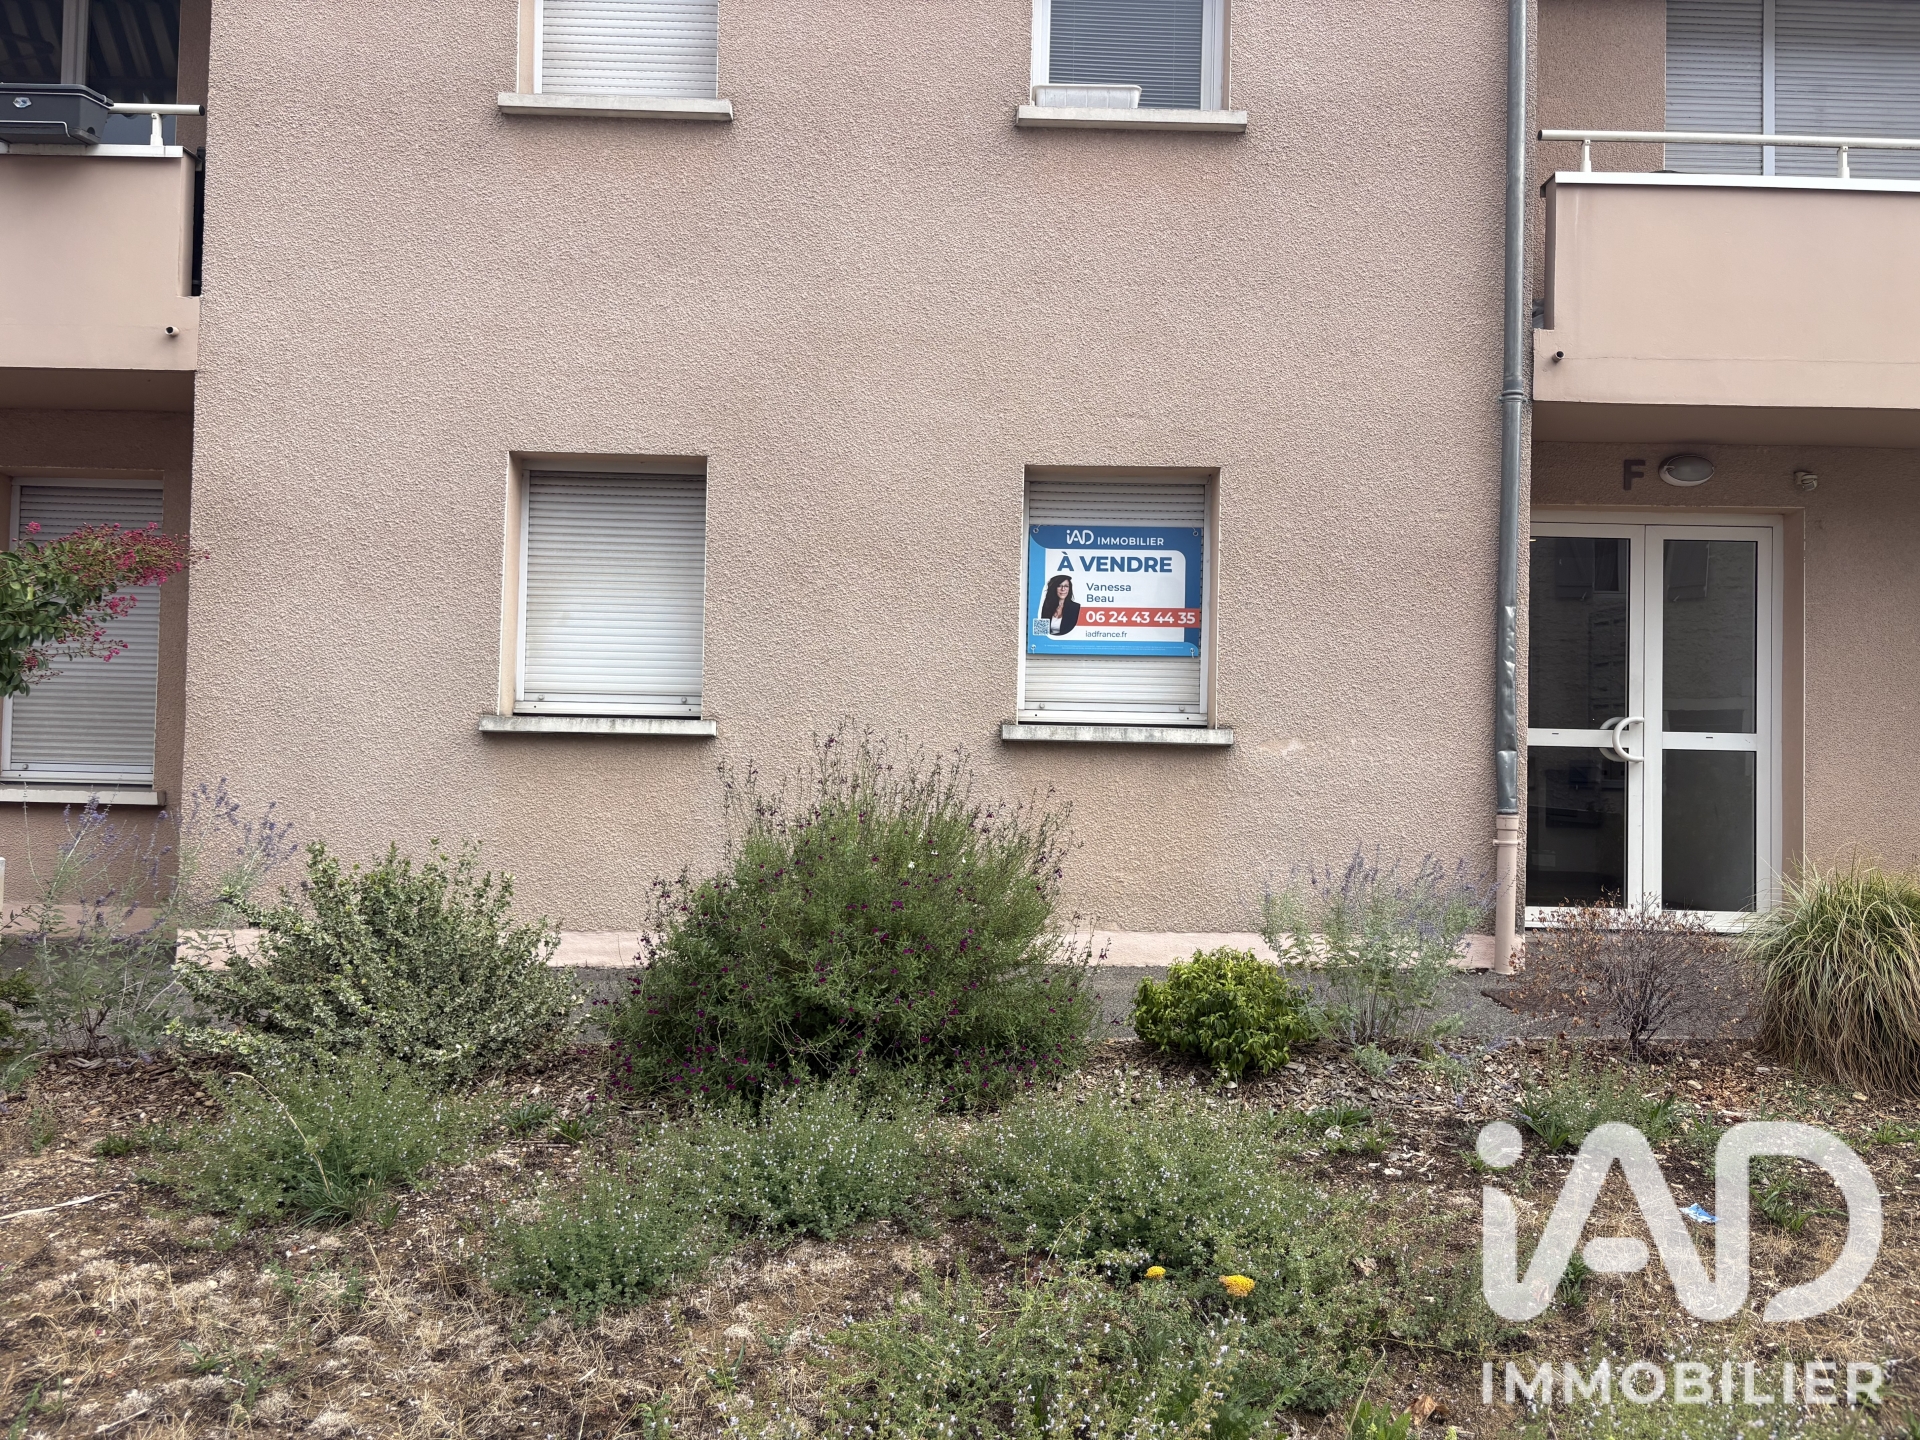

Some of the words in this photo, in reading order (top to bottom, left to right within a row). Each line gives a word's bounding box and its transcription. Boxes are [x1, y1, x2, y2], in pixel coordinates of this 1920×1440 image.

[1623, 459, 1646, 491] F
[1097, 537, 1164, 546] IMMOBILIER
[1057, 551, 1074, 572] À
[1079, 556, 1173, 573] VENDRE
[1086, 583, 1131, 592] Vanessa
[1086, 594, 1114, 603] Beau
[1085, 611, 1105, 623] 06
[1108, 611, 1127, 623] 24
[1131, 611, 1150, 624] 43
[1153, 612, 1174, 624] 44
[1177, 612, 1196, 625] 35
[1085, 630, 1128, 638] iadfrance.fr
